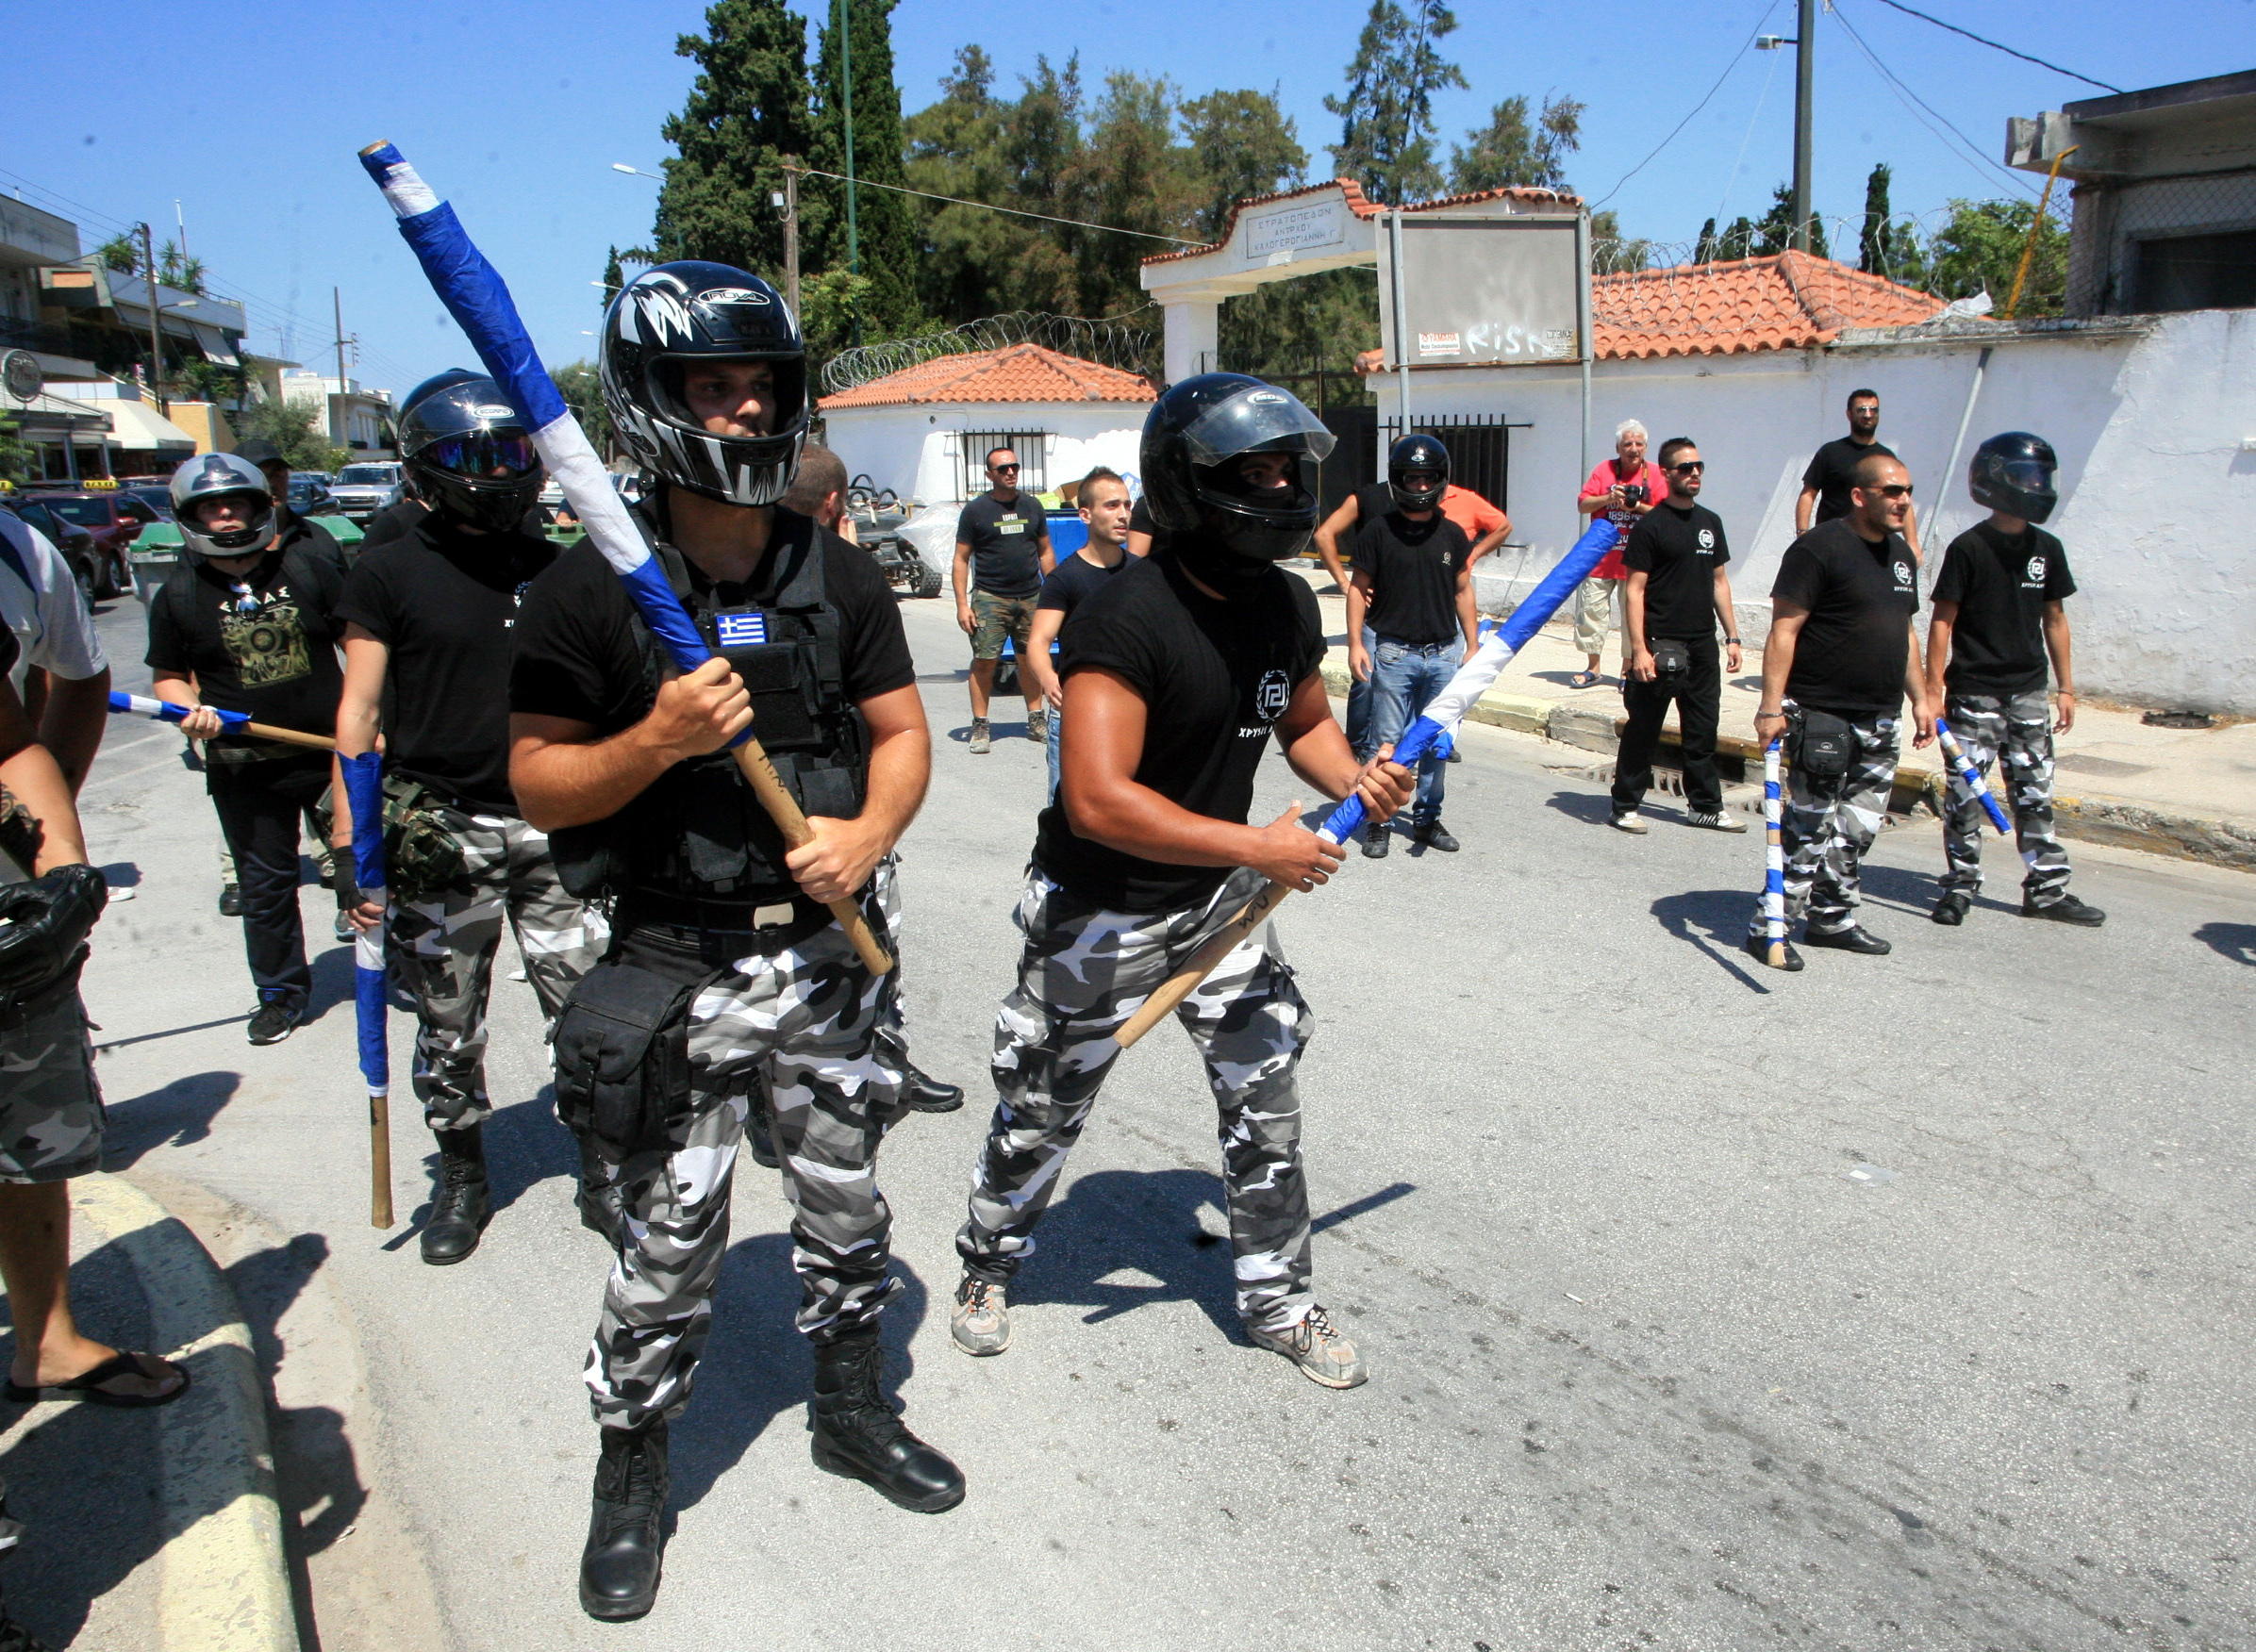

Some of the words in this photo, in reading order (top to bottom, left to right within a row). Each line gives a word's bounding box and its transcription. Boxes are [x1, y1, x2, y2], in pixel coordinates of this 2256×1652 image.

[1258, 207, 1331, 229] ΣΤΡΑΤΟΠΕΔΟΝ
[1430, 332, 1456, 341] YAMAHA
[1608, 511, 1631, 520] 1896
